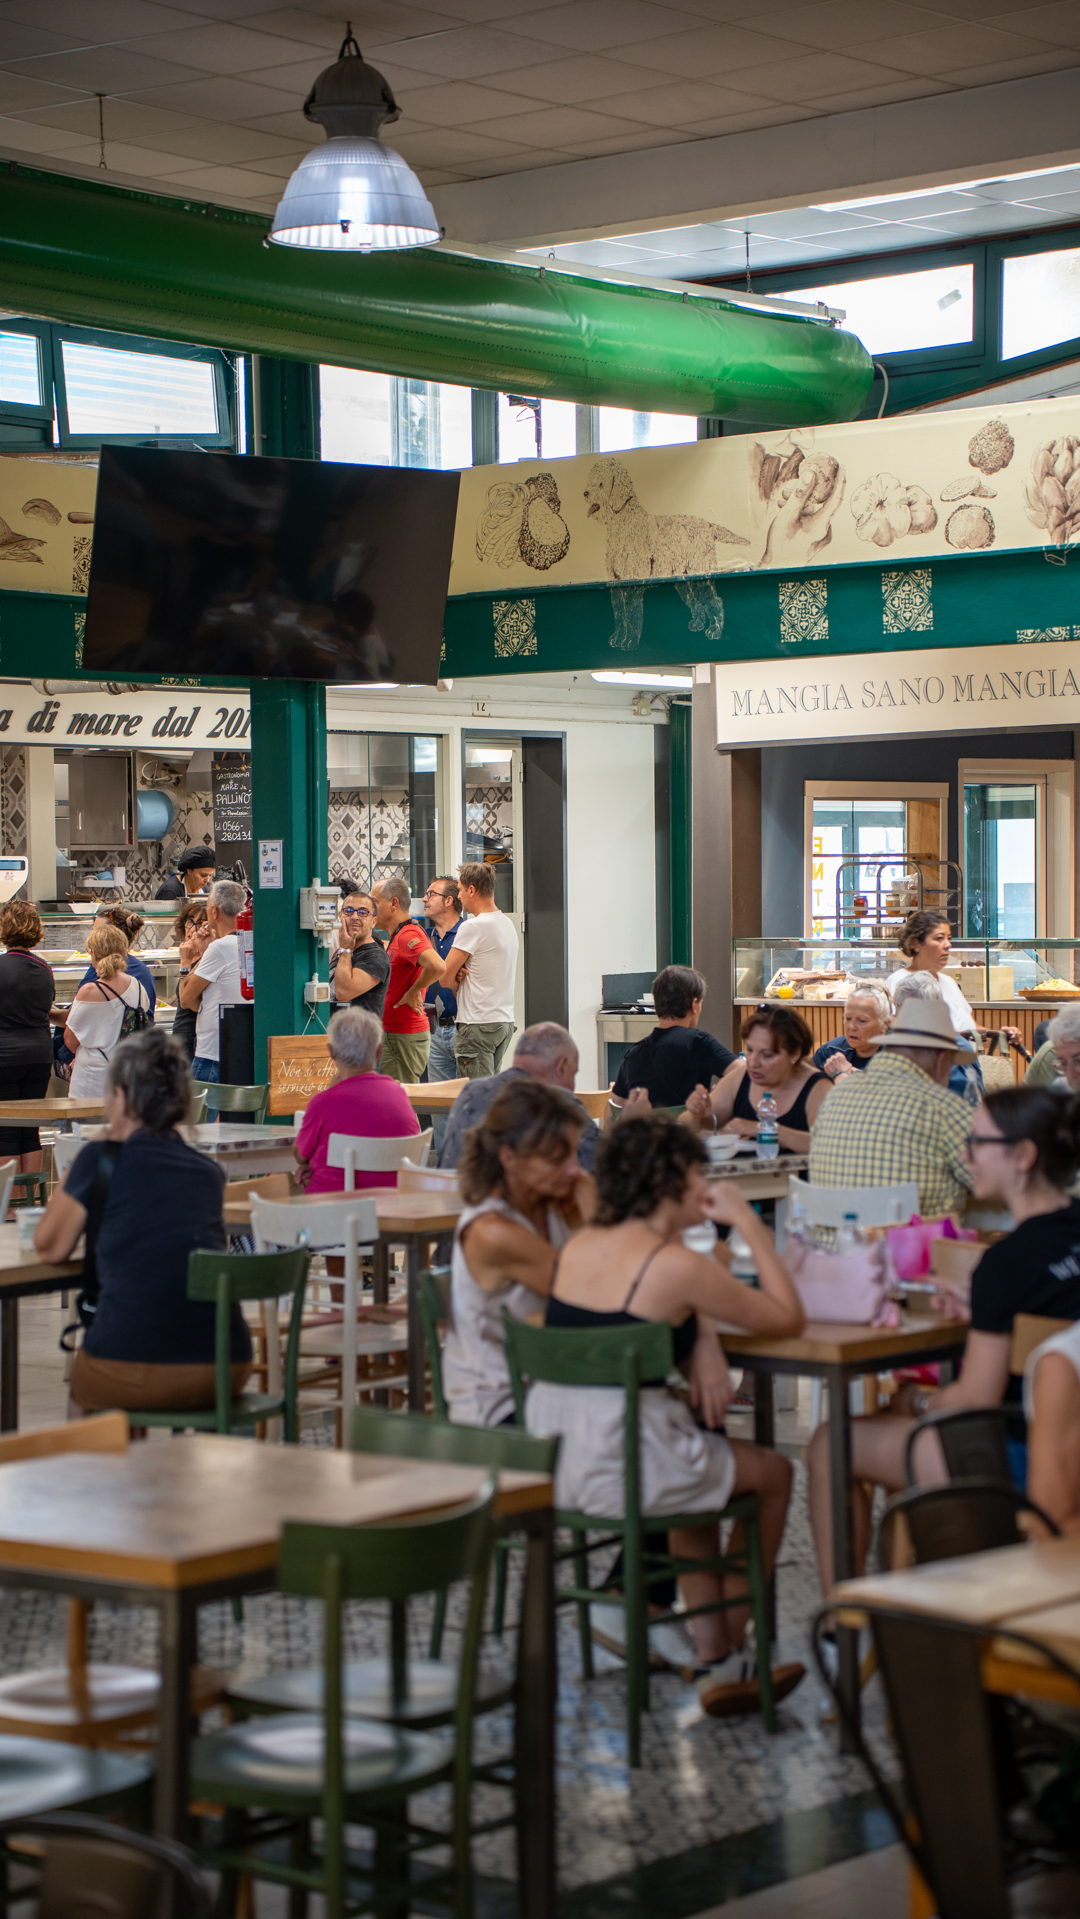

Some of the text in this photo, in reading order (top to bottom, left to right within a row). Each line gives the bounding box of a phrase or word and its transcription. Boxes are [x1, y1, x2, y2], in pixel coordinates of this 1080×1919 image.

[731, 668, 1080, 717] MANGIA SANO MANGIA
[27, 700, 61, 733] di
[66, 711, 143, 737] mare
[152, 706, 201, 738] dal
[263, 865, 277, 873] Wi-Fi
[277, 1059, 302, 1078] Non
[304, 1063, 314, 1077] si
[276, 1079, 316, 1097] servizio
